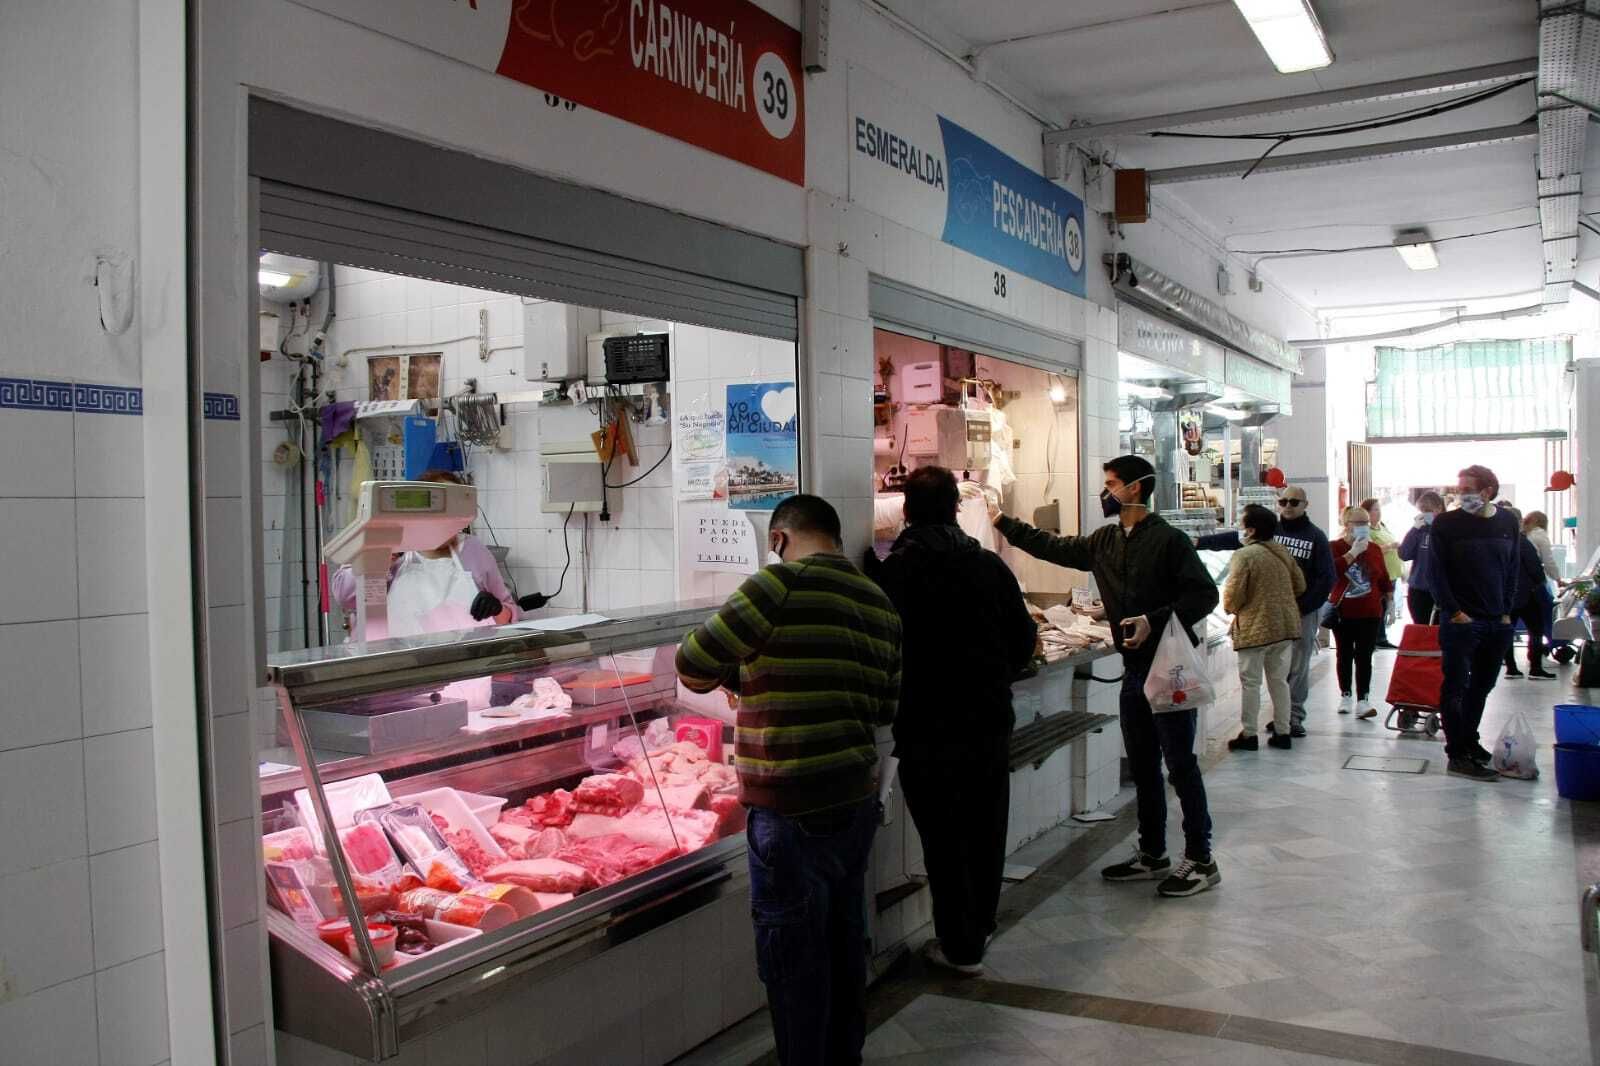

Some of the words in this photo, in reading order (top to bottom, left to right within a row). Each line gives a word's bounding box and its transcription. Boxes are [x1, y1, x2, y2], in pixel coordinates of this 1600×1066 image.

[630, 0, 746, 112] CARNICERÍA
[763, 71, 788, 119] 39
[855, 116, 945, 191] ESMERALDA
[993, 180, 1065, 258] PESCADERÍA
[1068, 230, 1080, 258] 38
[993, 271, 1007, 298] 38
[729, 401, 748, 414] YO
[729, 412, 760, 424] AMO
[729, 421, 744, 433] MI
